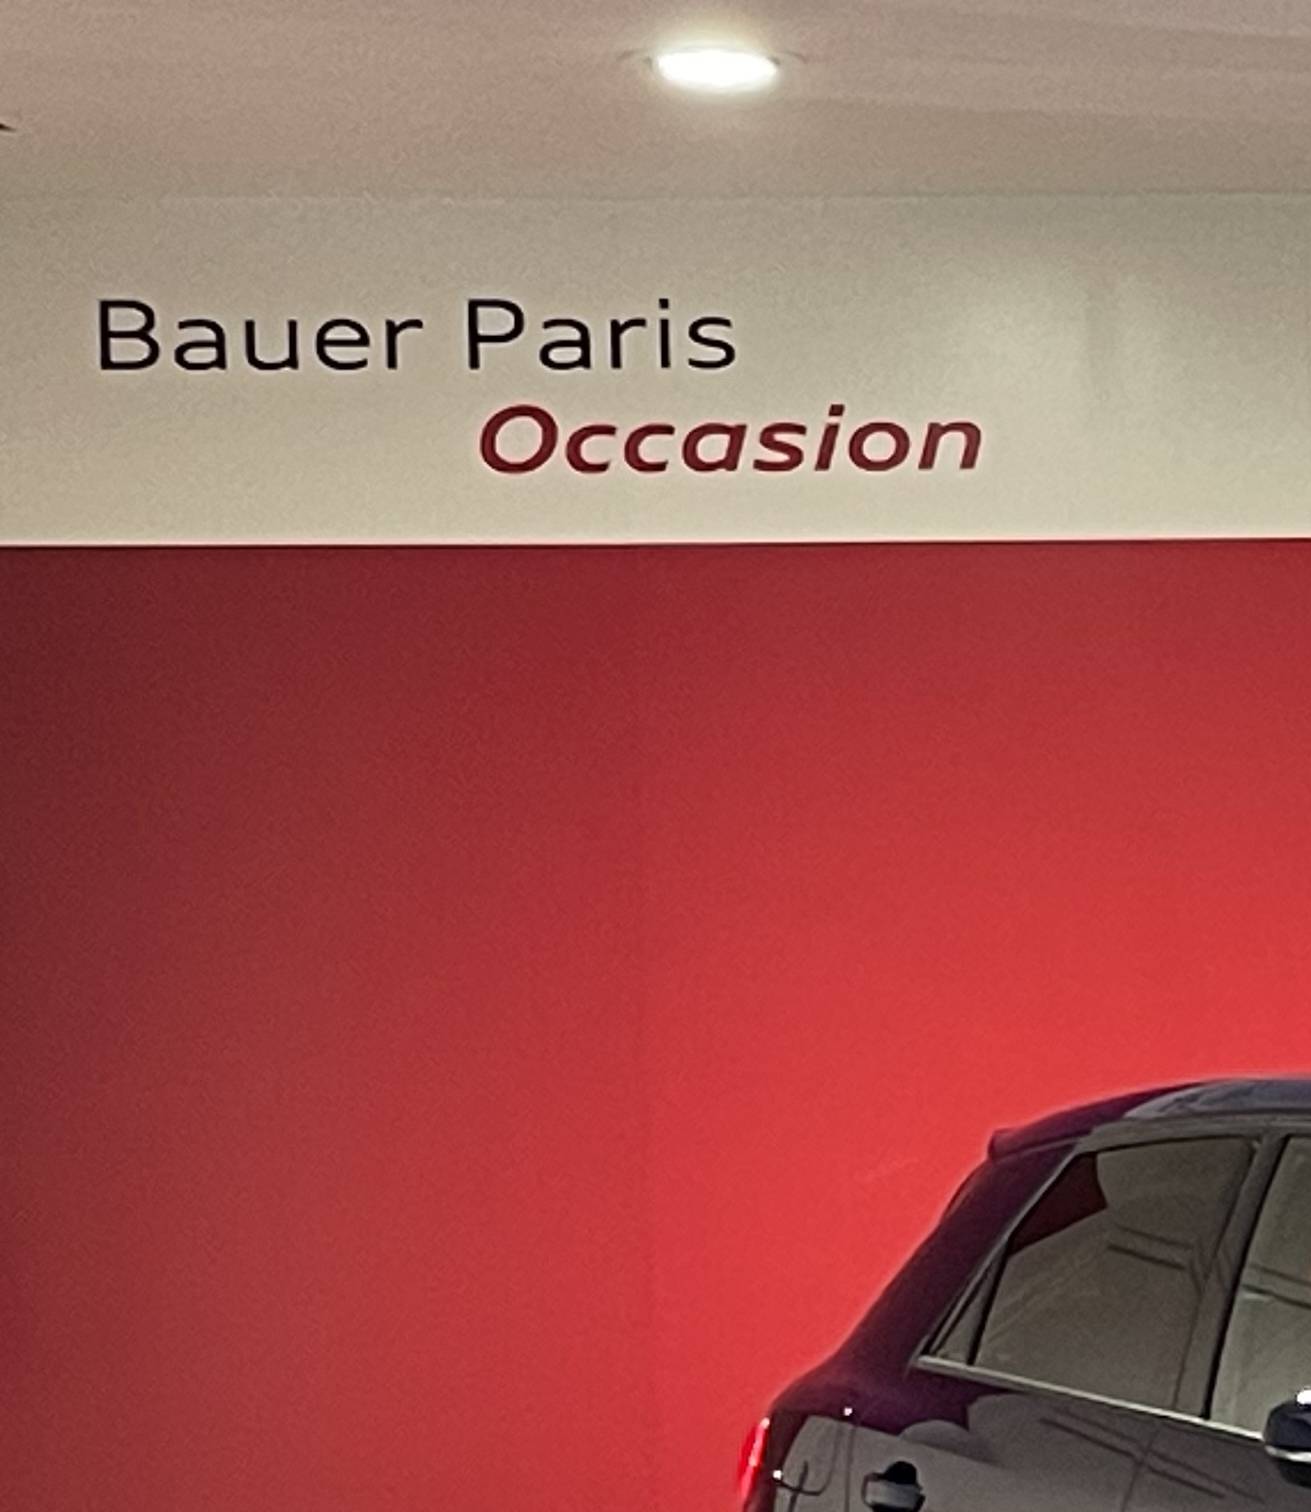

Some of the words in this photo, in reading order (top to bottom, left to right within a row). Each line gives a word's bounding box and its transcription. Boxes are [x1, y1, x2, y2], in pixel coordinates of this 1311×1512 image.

[98, 298, 423, 371] Bauer
[466, 298, 737, 371] Paris
[479, 404, 983, 475] Occasion
